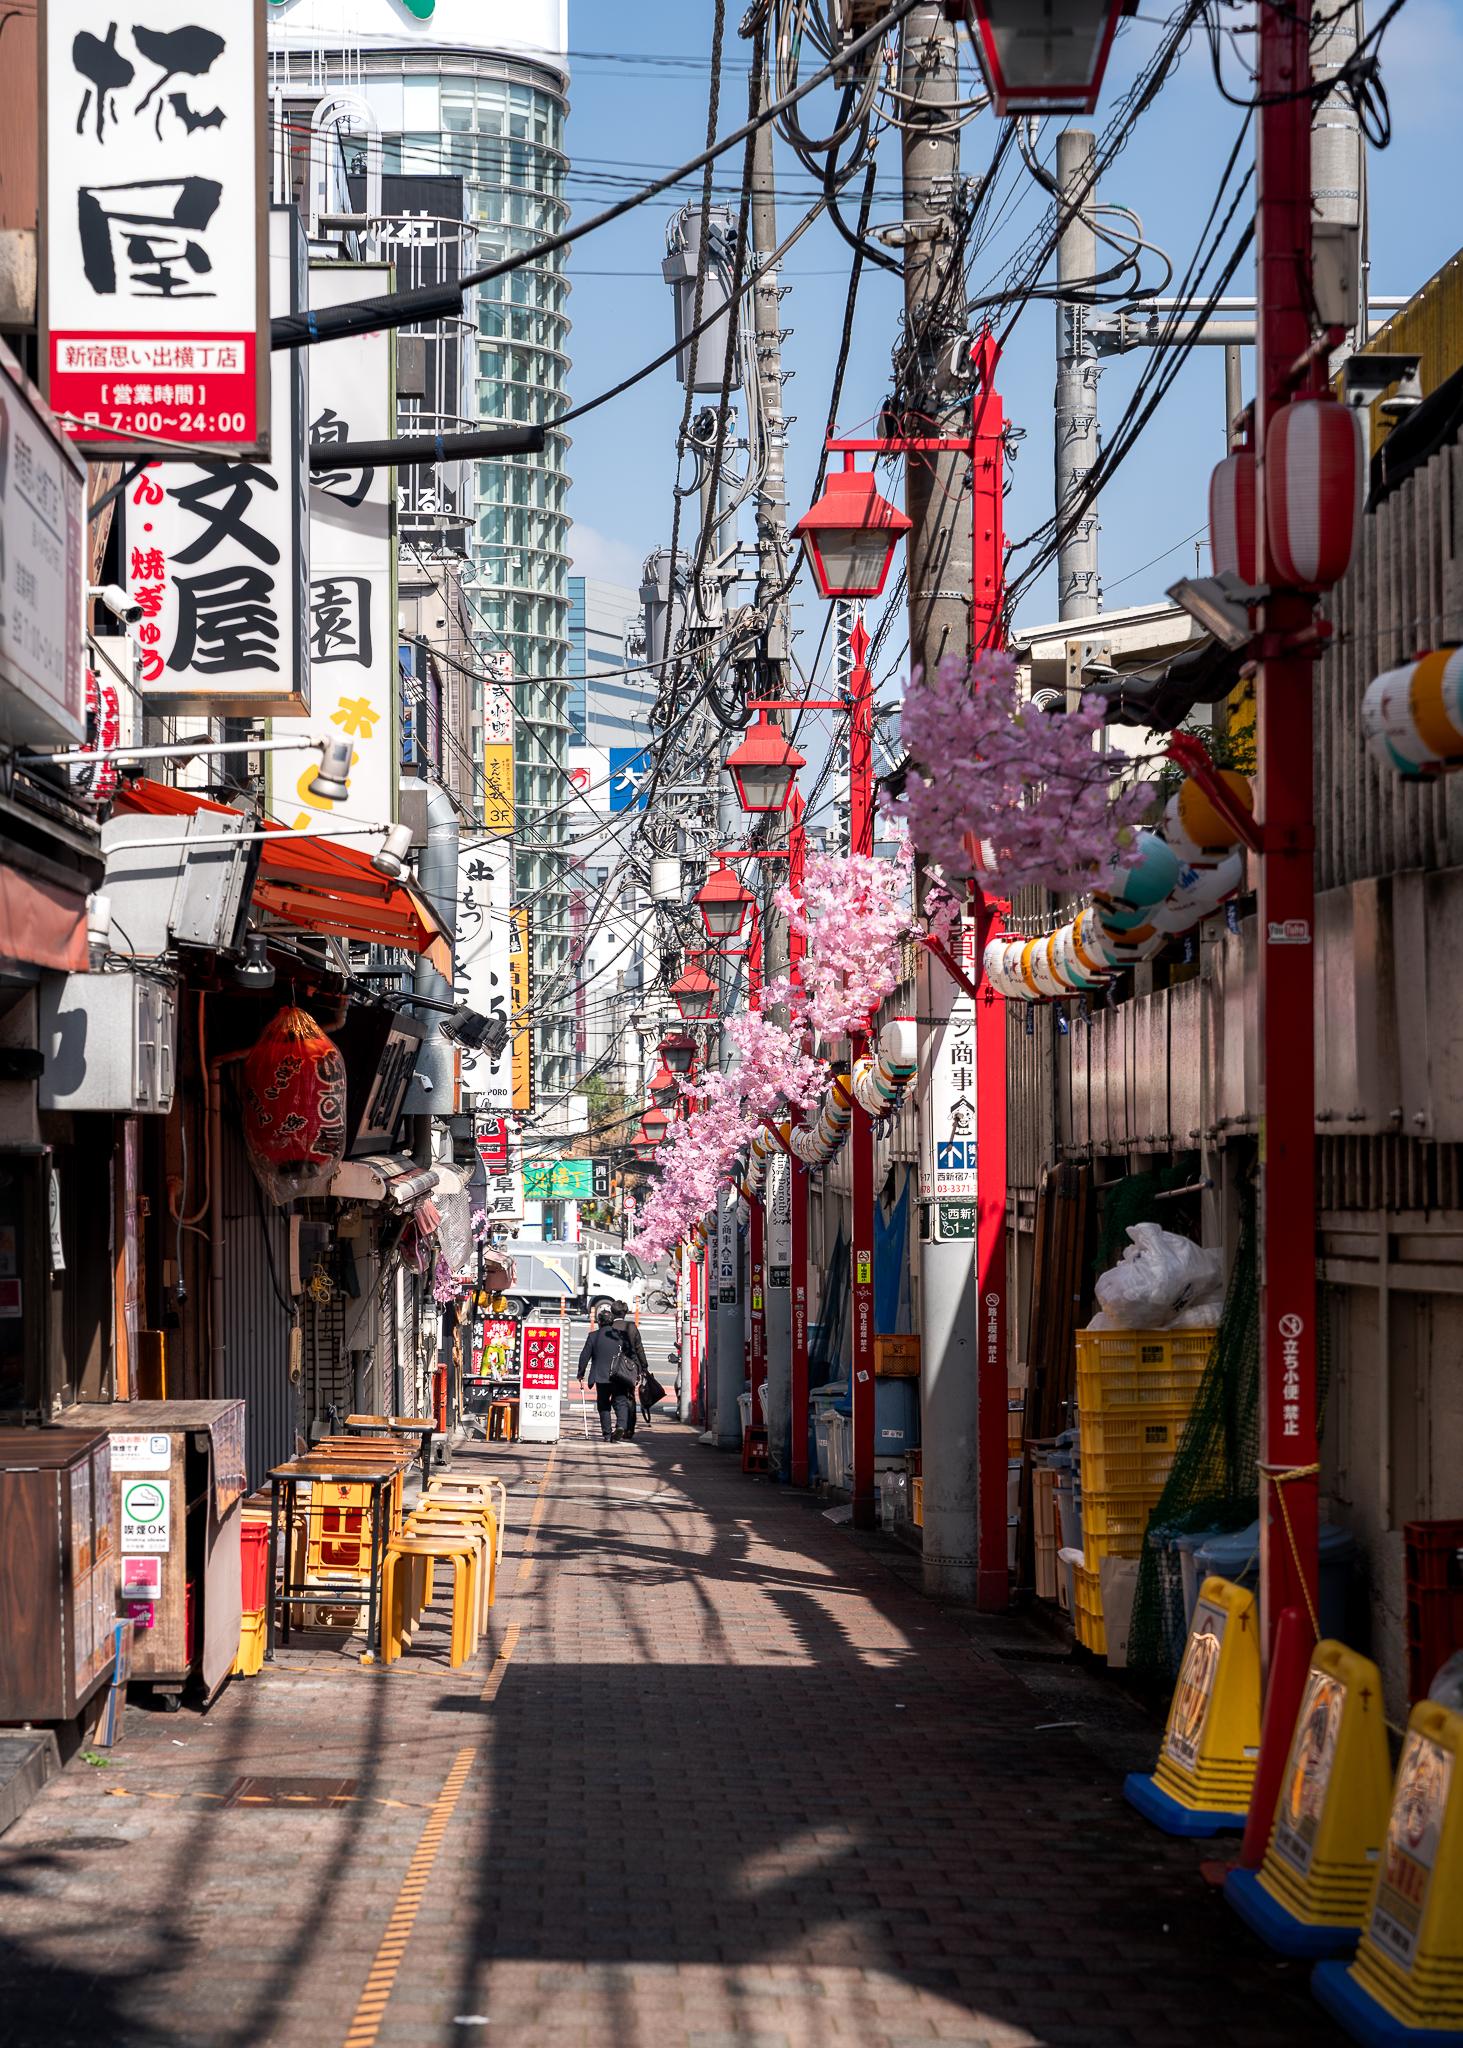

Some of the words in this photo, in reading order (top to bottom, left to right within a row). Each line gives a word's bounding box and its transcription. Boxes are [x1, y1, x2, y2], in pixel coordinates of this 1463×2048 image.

[65, 345, 237, 368] 新宿思い出横丁店
[490, 809, 510, 822] 3F
[937, 1172, 977, 1181] 西新宿7-1
[777, 1178, 787, 1216] Dorothy
[947, 1208, 975, 1220] 西新
[988, 1344, 998, 1364] 禁止
[1283, 1339, 1300, 1401] 立ち小便
[1283, 1403, 1300, 1437] 禁止
